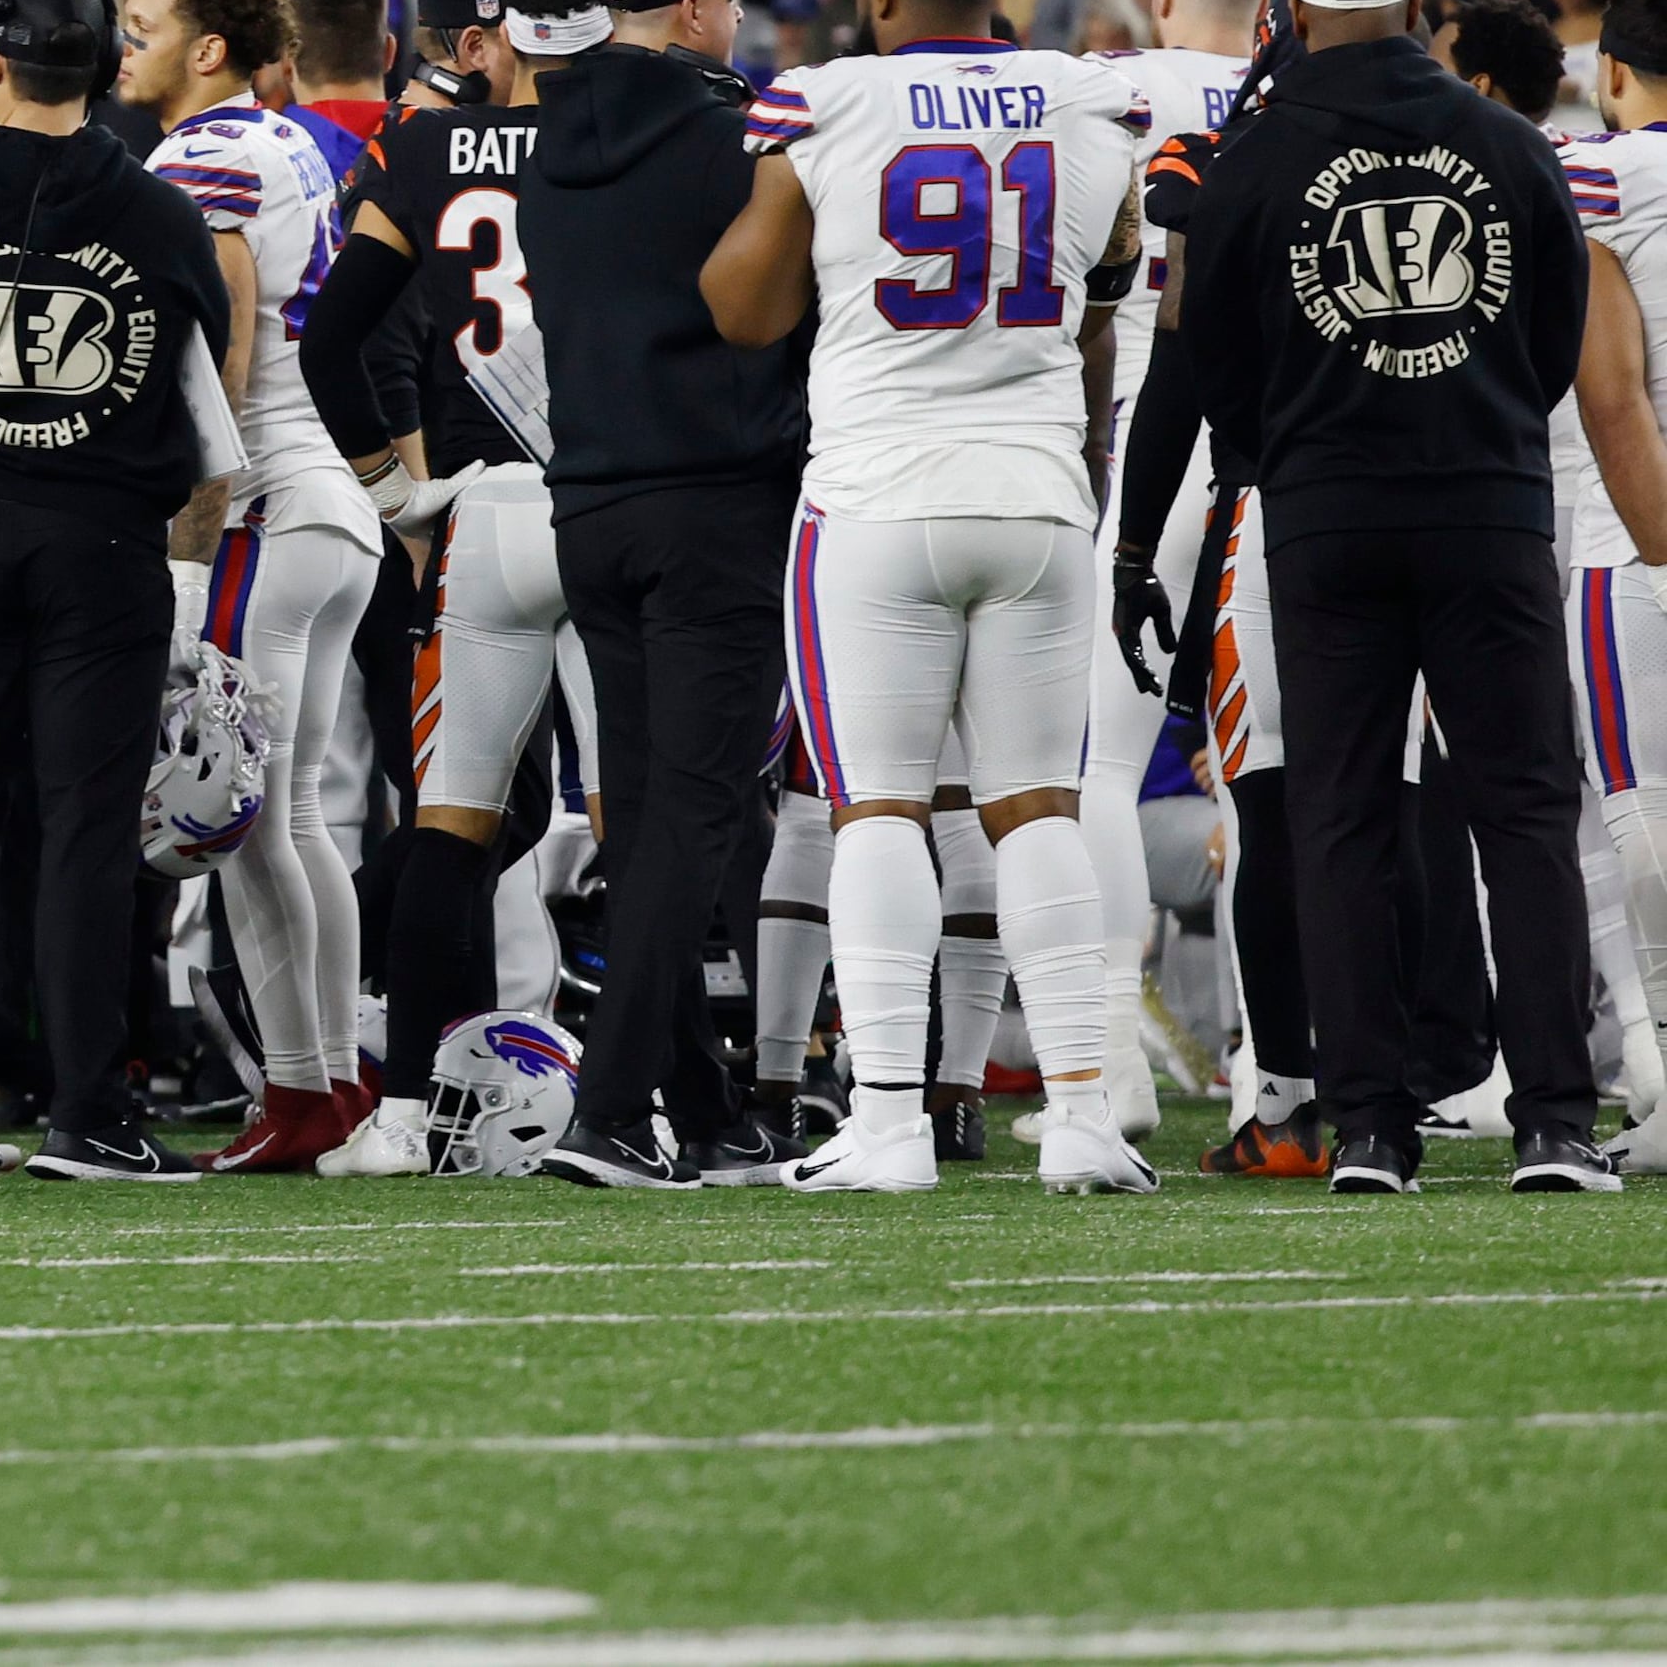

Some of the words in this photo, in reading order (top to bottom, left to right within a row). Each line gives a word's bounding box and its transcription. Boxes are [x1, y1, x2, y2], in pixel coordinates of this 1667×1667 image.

[909, 82, 1047, 131] OLIVER
[874, 139, 1066, 331] 91
[1473, 220, 1513, 324] EQUITY
[1289, 242, 1353, 342] JUSTICE
[114, 308, 157, 403] EQUITY
[1362, 329, 1470, 379] FREEDOM
